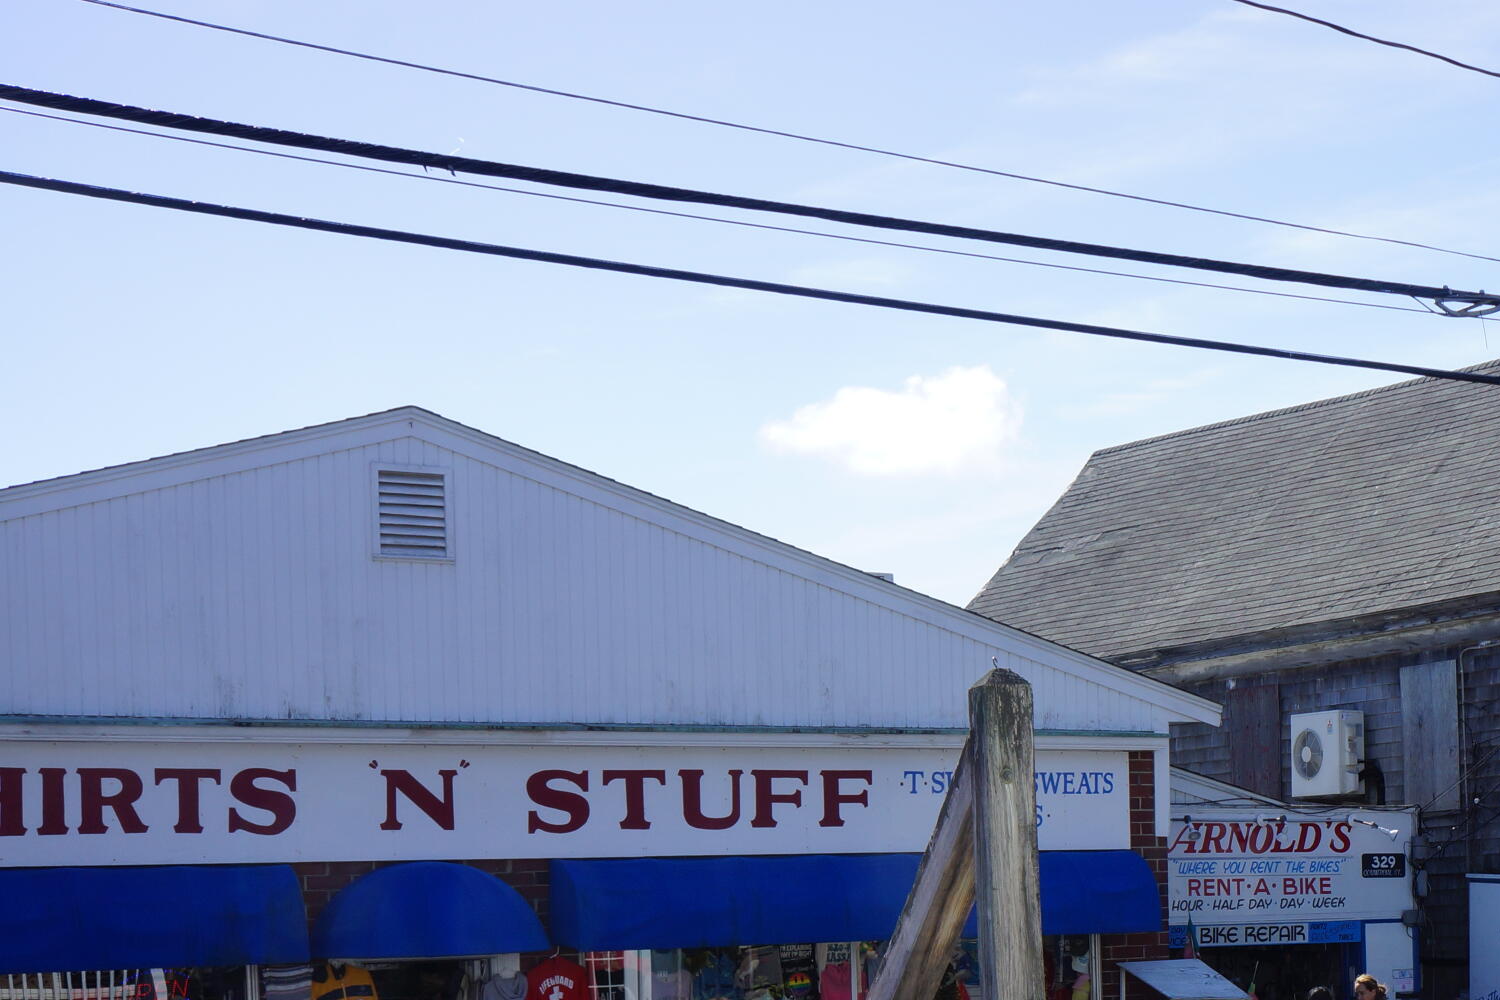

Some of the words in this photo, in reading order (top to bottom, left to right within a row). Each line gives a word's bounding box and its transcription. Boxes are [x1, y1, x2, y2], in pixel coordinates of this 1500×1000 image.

[526, 769, 872, 834] STUFF
[1168, 818, 1352, 854] ARNOLD'S
[1224, 861, 1247, 874] YOU
[1250, 860, 1282, 874] RENT
[1286, 860, 1305, 873] THE
[1371, 856, 1396, 868] 329
[1172, 900, 1204, 911] HOUR
[1212, 899, 1245, 910] HALF
[1249, 898, 1272, 910] DAY
[1280, 897, 1304, 909] DAY
[1312, 897, 1346, 908] WEEK
[1200, 927, 1238, 944] BIKE
[1245, 925, 1306, 942] REPAIR
